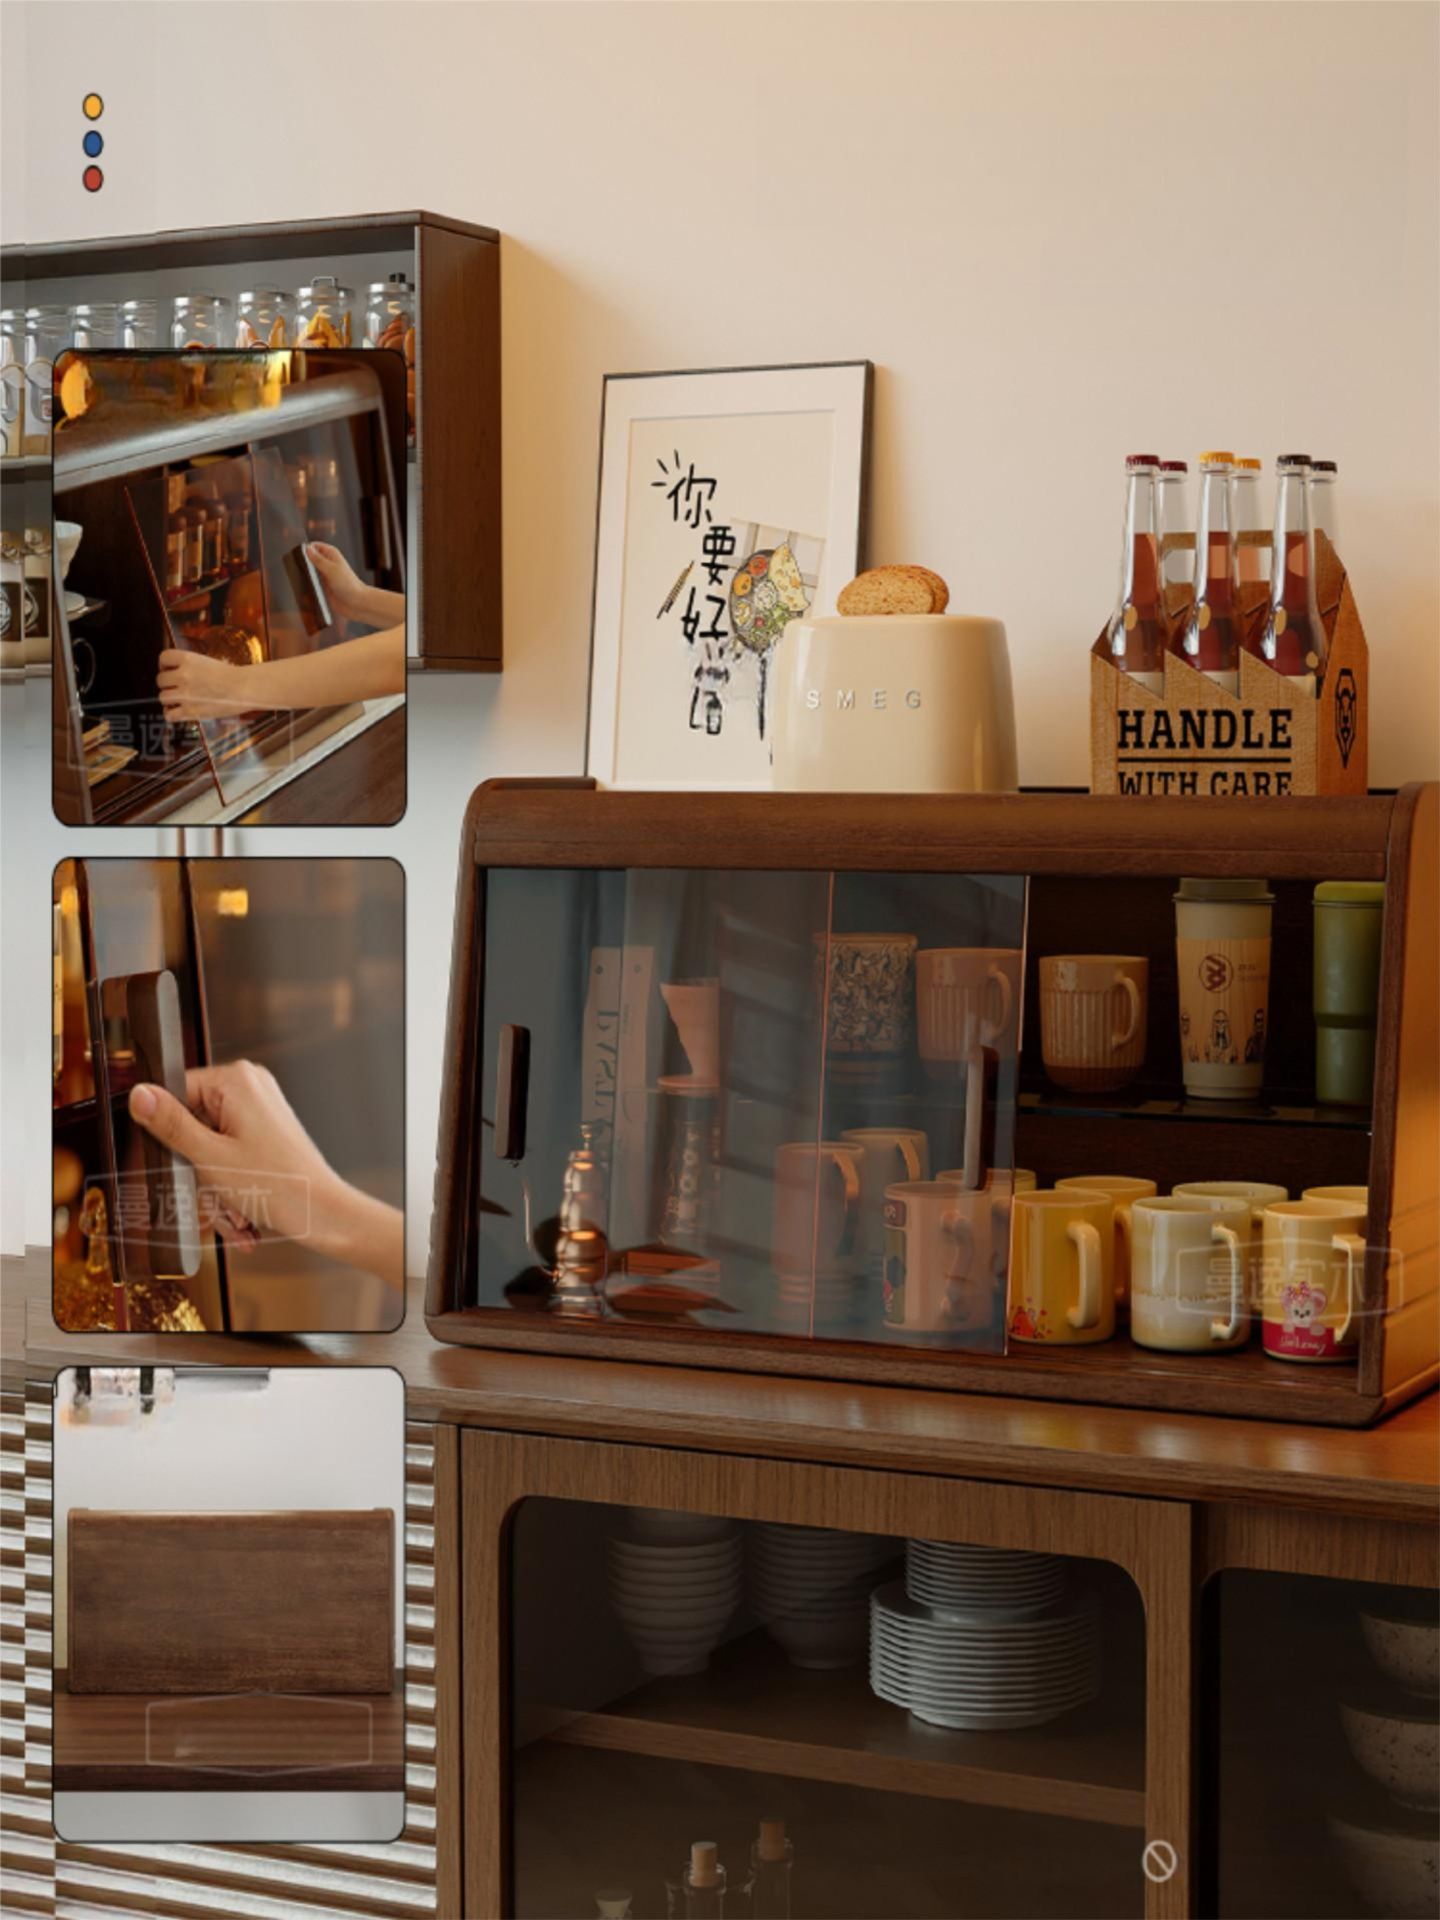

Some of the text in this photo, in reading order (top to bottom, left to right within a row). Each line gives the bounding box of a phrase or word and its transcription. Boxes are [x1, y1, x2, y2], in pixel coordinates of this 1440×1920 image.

[806, 689, 921, 710] SMEG
[1117, 709, 1292, 749] HANDLE
[1117, 771, 1292, 796] WITH CARE
